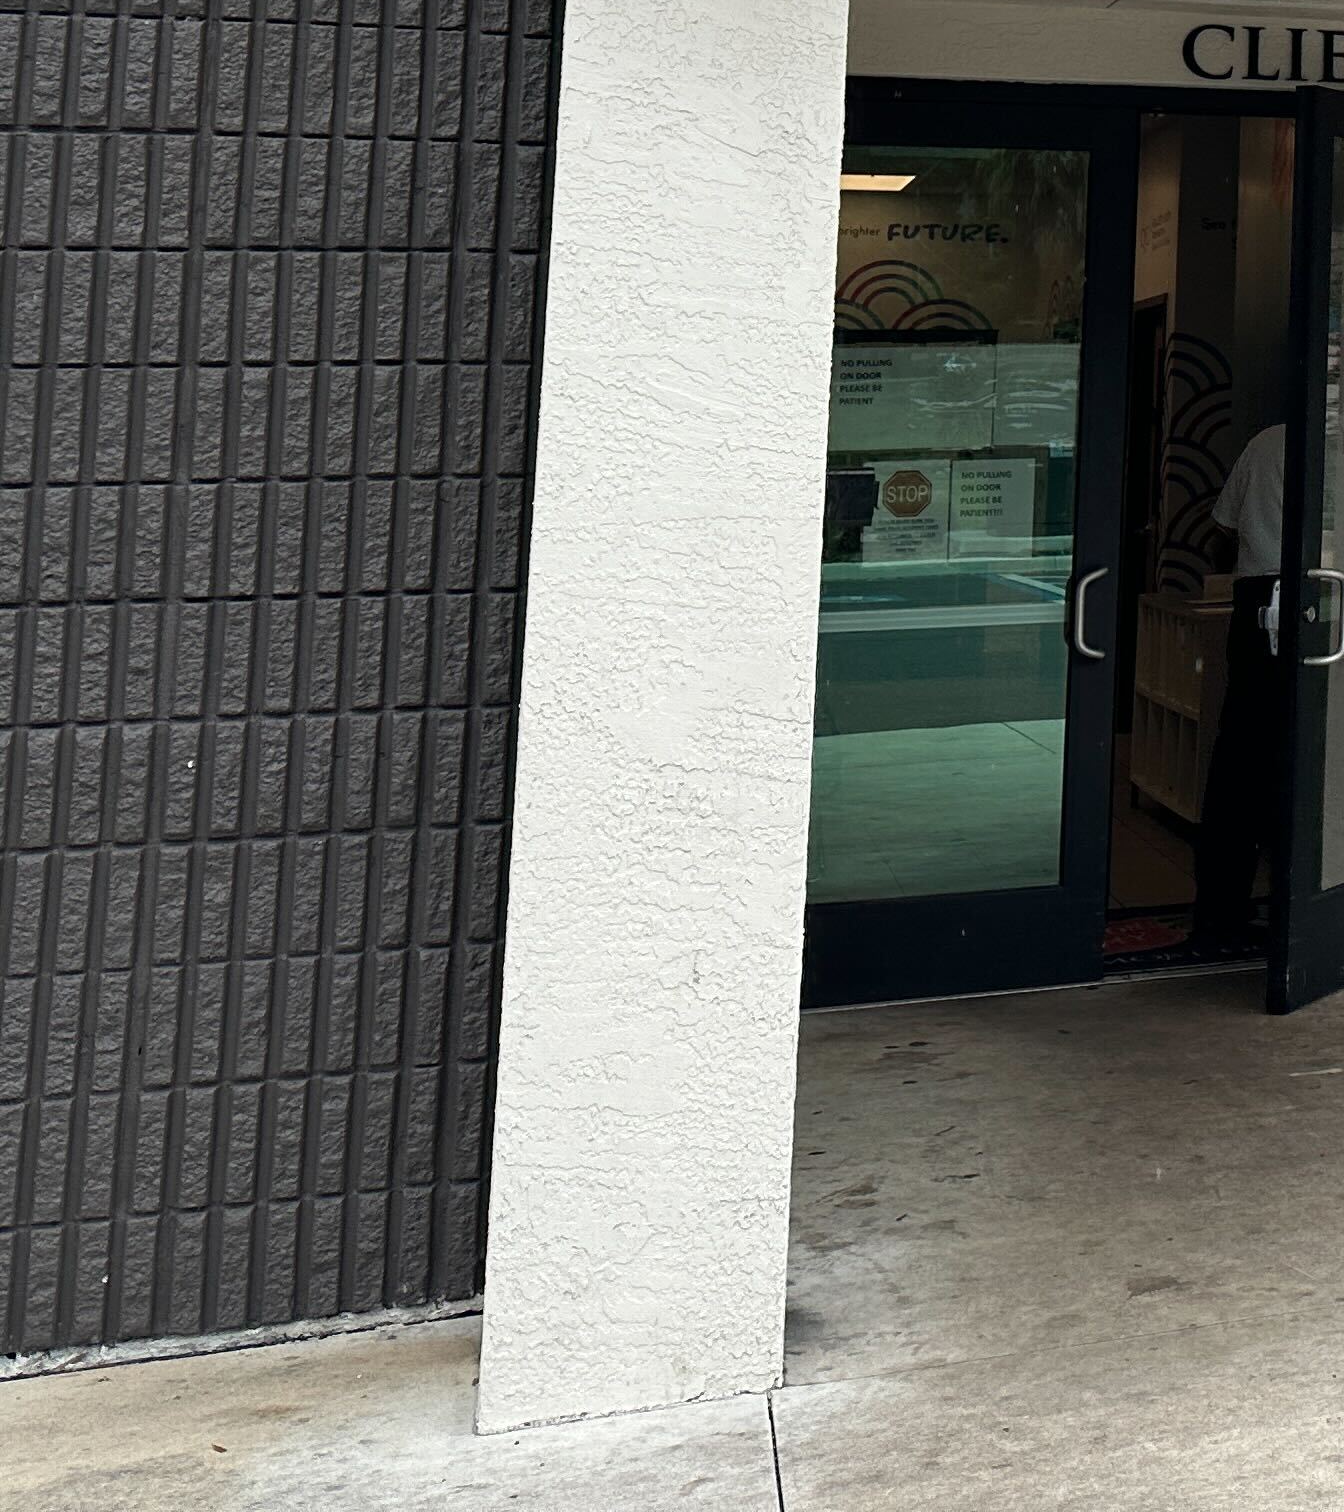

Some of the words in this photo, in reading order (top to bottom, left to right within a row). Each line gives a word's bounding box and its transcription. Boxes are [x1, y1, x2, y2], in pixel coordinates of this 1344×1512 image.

[888, 223, 1009, 244] FUTURE.
[841, 359, 854, 367] NO
[840, 372, 854, 380] ON
[839, 384, 872, 393] PLEASE
[839, 397, 874, 405] PATIENT
[961, 471, 975, 479] NO
[961, 484, 974, 492] ON
[976, 483, 1001, 491] DOOR
[886, 486, 929, 503] STOP
[960, 496, 990, 504] PLEASE
[992, 495, 1003, 504] BE
